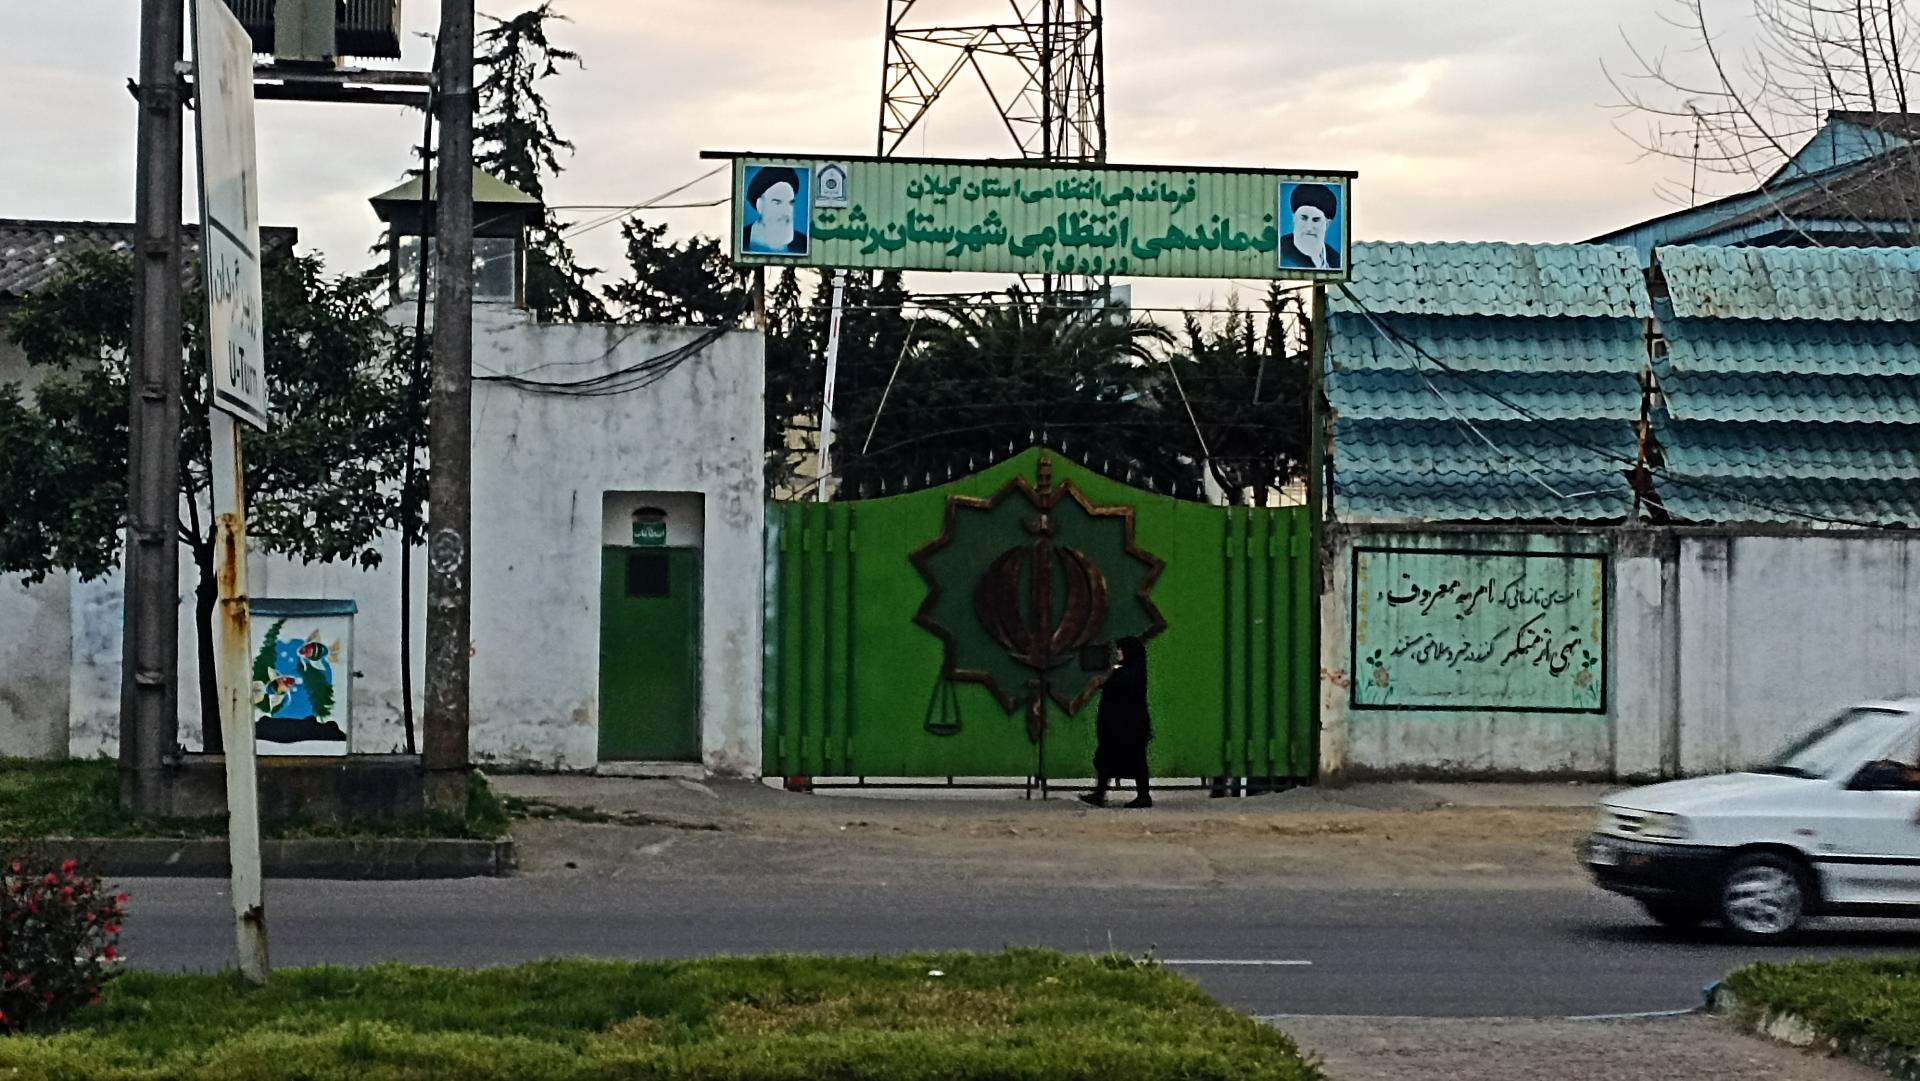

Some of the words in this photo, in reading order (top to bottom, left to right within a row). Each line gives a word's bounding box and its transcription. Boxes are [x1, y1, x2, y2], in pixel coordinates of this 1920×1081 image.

[906, 174, 961, 204] گیلان
[963, 178, 1021, 201] استان
[1020, 176, 1101, 204] انتظامی
[1101, 177, 1196, 214] فرماندهی
[810, 204, 881, 255] رشت
[880, 208, 1007, 258] شهرستان
[1008, 210, 1129, 257] انتظامی
[1056, 254, 1129, 275] ورودی
[228, 339, 258, 400] U-Turn
[1386, 572, 1461, 617] معروف
[1463, 577, 1496, 616] امر
[1499, 611, 1546, 667] منکر
[1531, 627, 1552, 665] از
[1548, 625, 1582, 678] نهی
